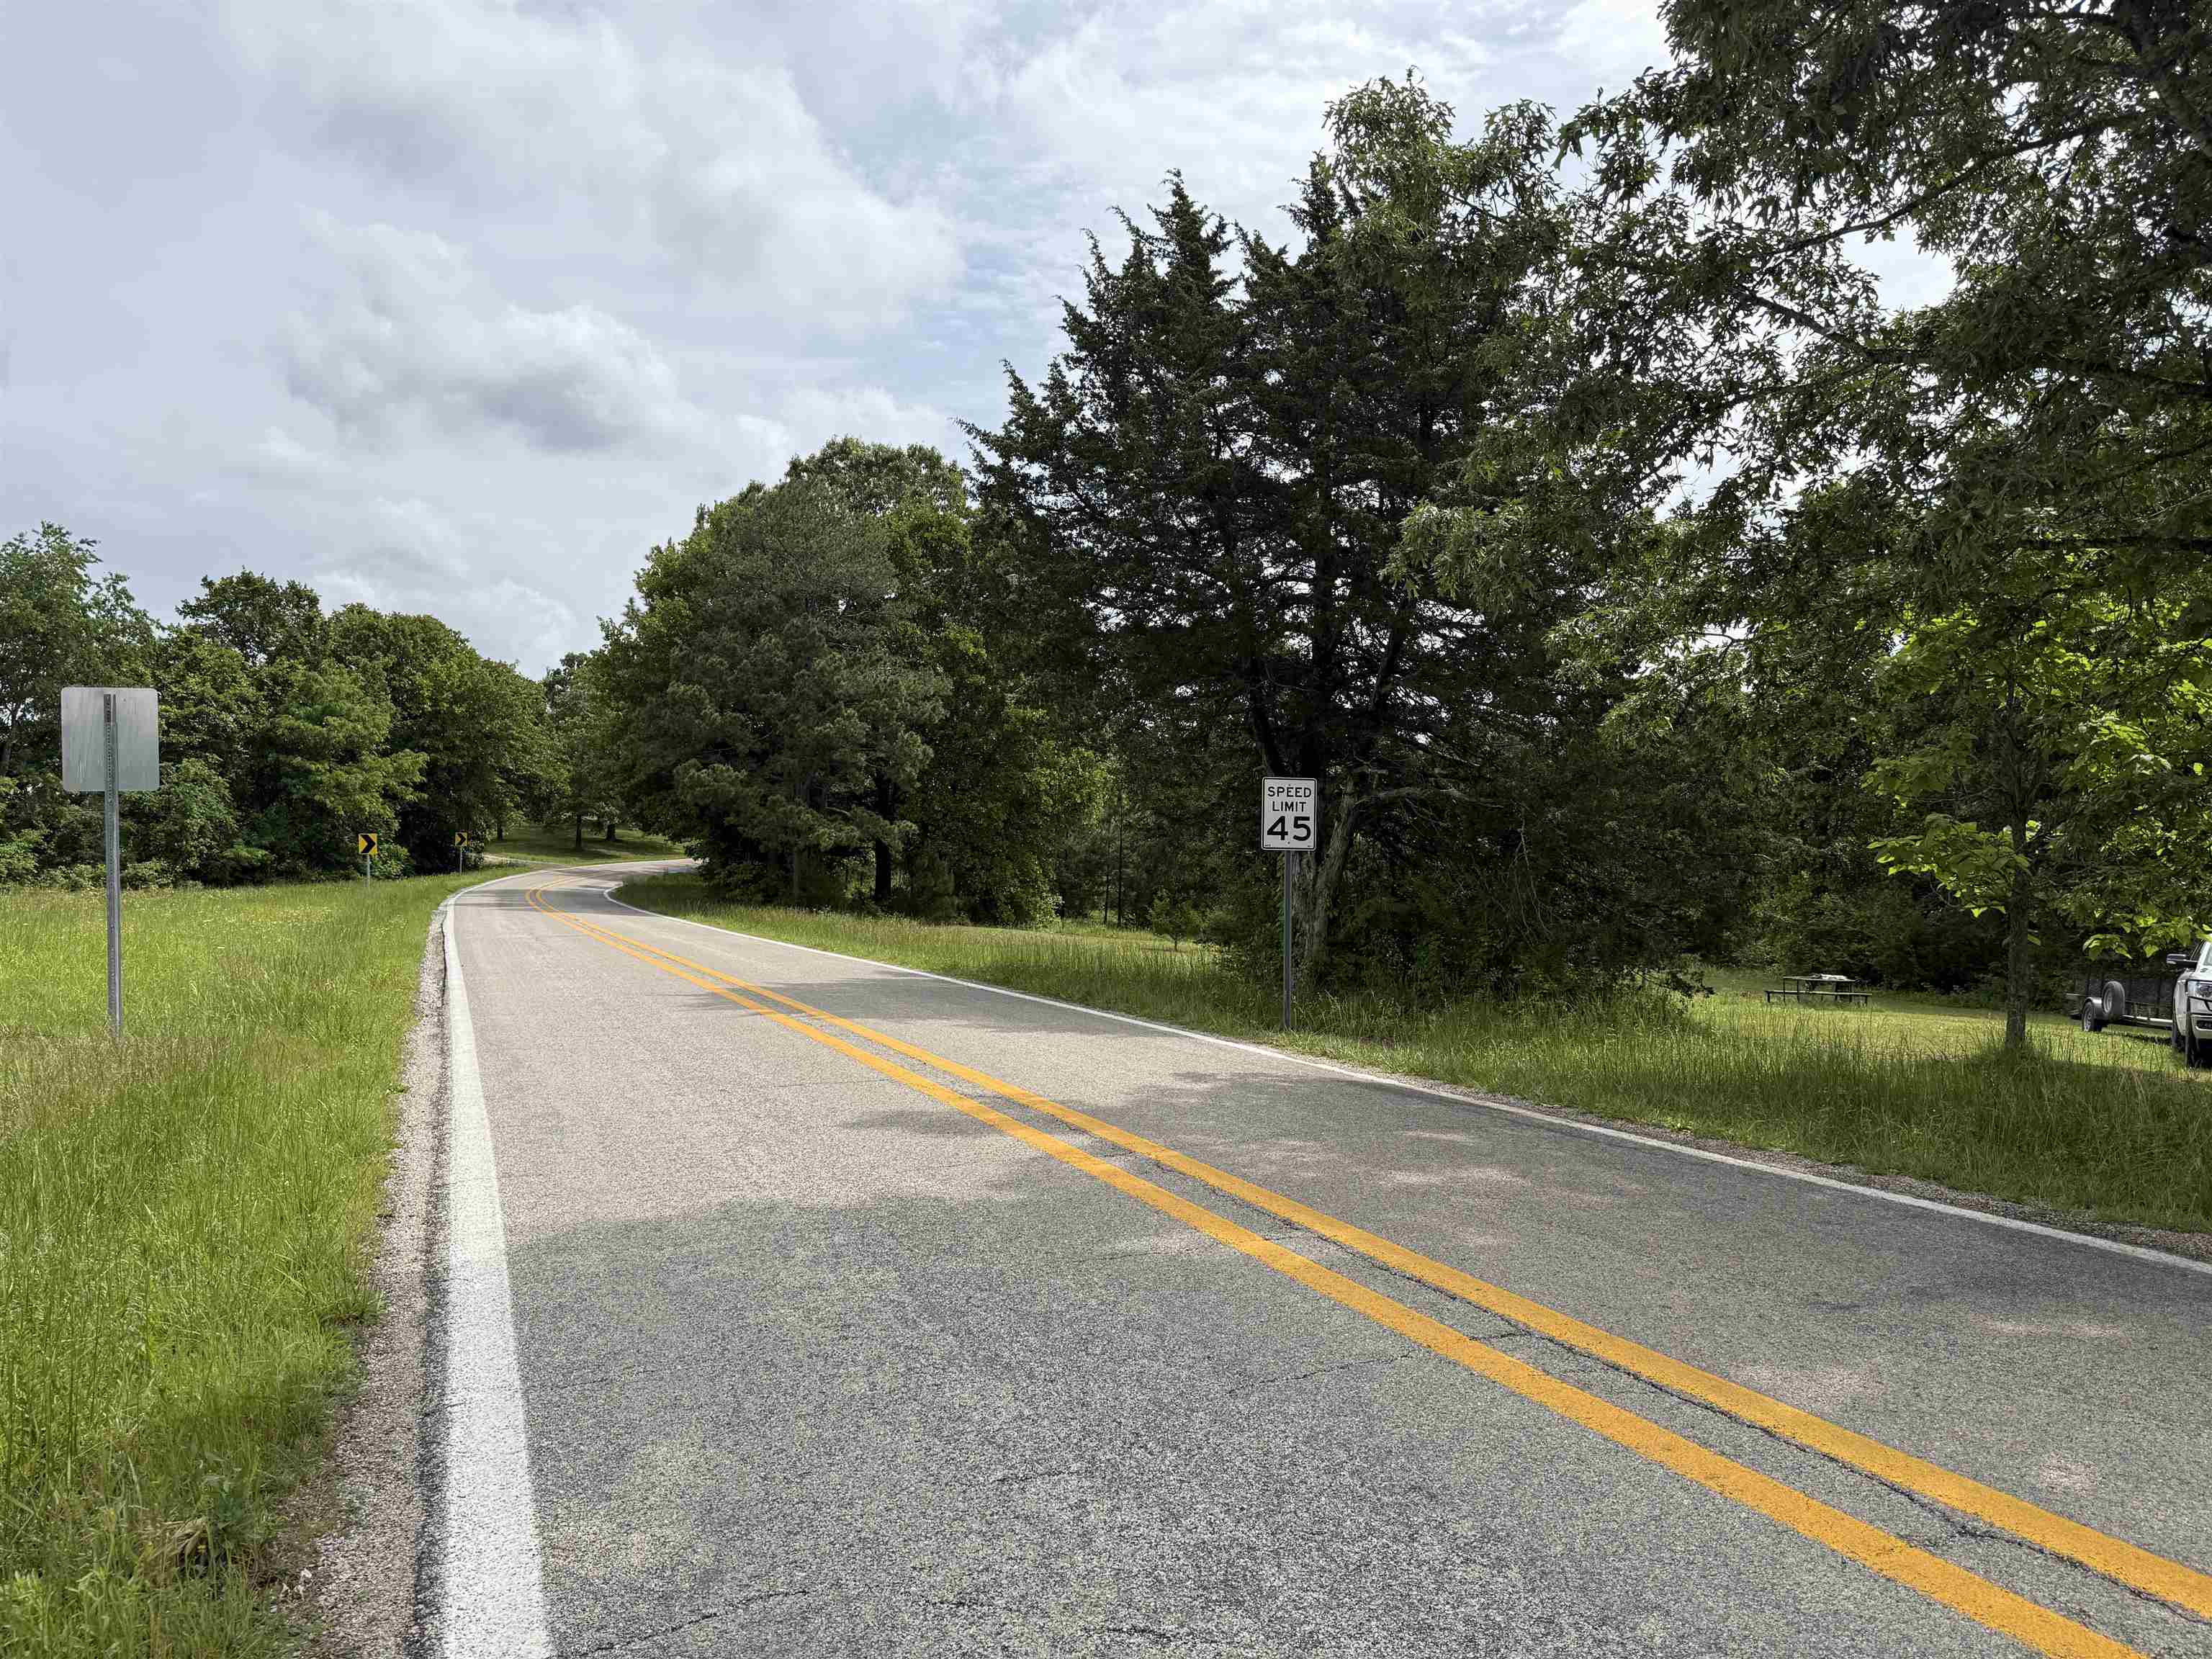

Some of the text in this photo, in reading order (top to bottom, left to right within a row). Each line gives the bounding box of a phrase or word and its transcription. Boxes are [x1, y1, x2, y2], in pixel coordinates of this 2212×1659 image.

[1268, 786, 1311, 797] SPEED
[1272, 801, 1306, 811] LIMIT
[1267, 816, 1311, 841] 45
